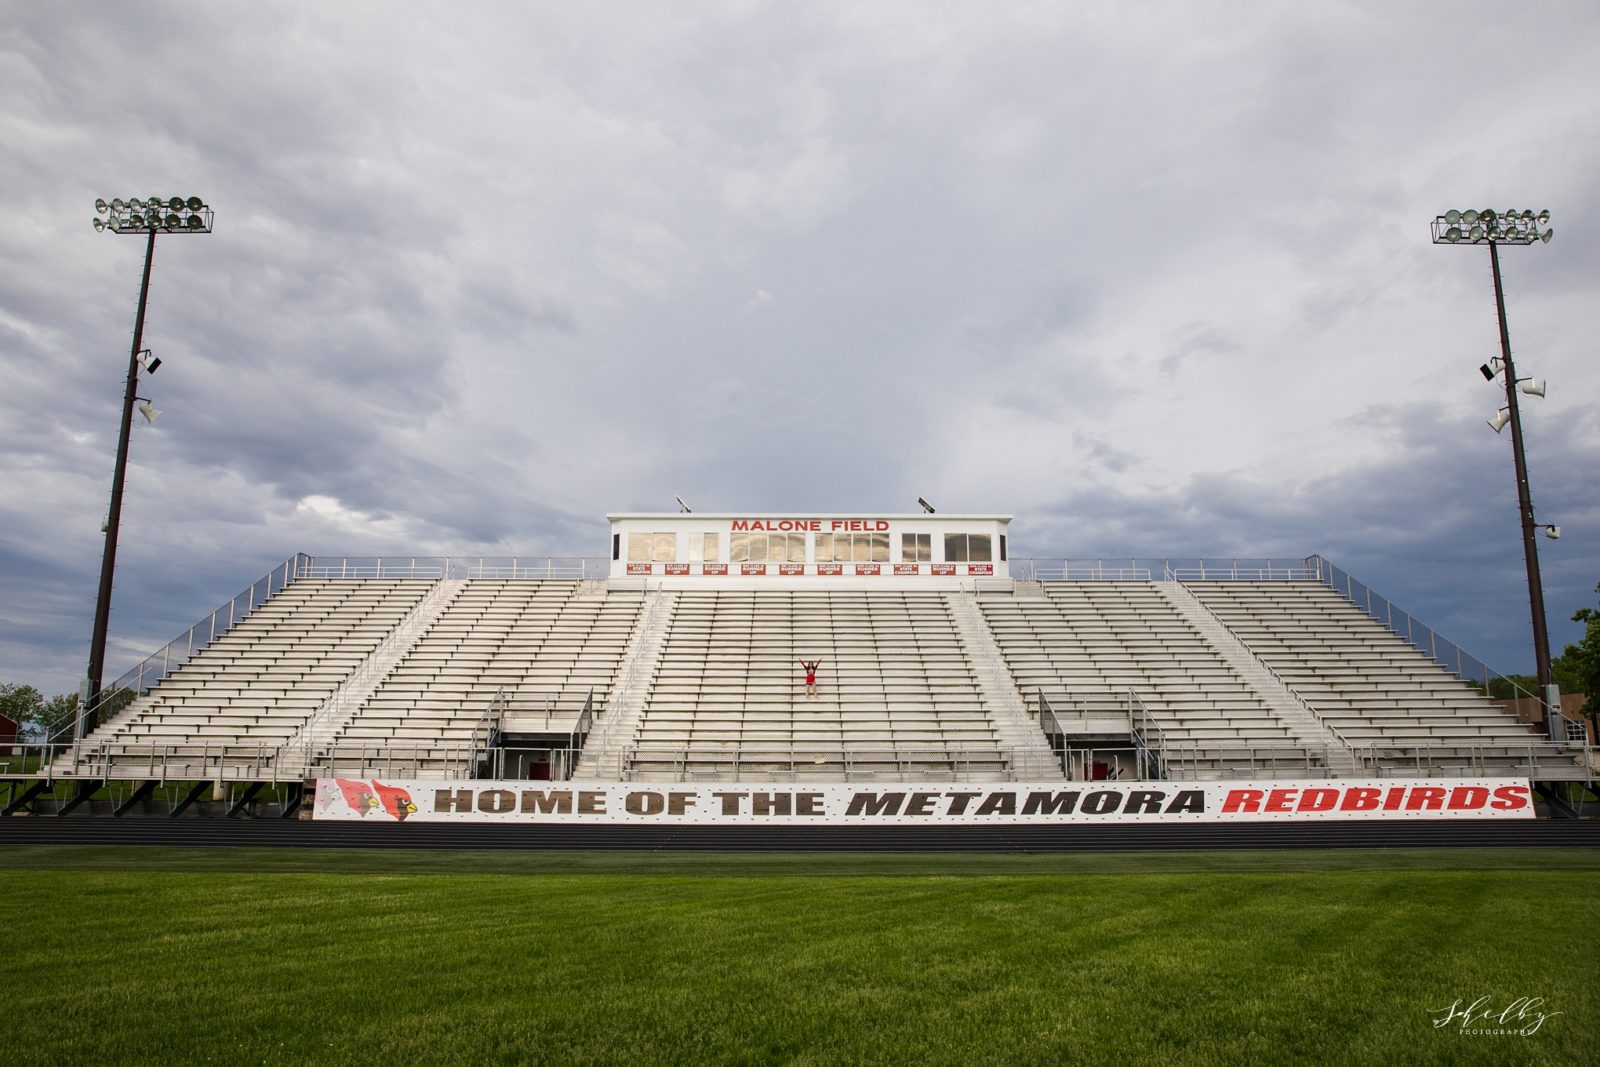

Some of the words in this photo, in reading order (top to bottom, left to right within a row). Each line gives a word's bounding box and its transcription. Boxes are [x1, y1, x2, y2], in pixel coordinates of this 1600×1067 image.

[731, 520, 821, 531] MALONE
[832, 520, 889, 531] FIELD
[433, 789, 607, 815] HOME
[625, 790, 699, 816] OF
[711, 791, 826, 816] THE
[844, 790, 1205, 816] METAMORA
[1221, 786, 1530, 813] REDBIRDS
